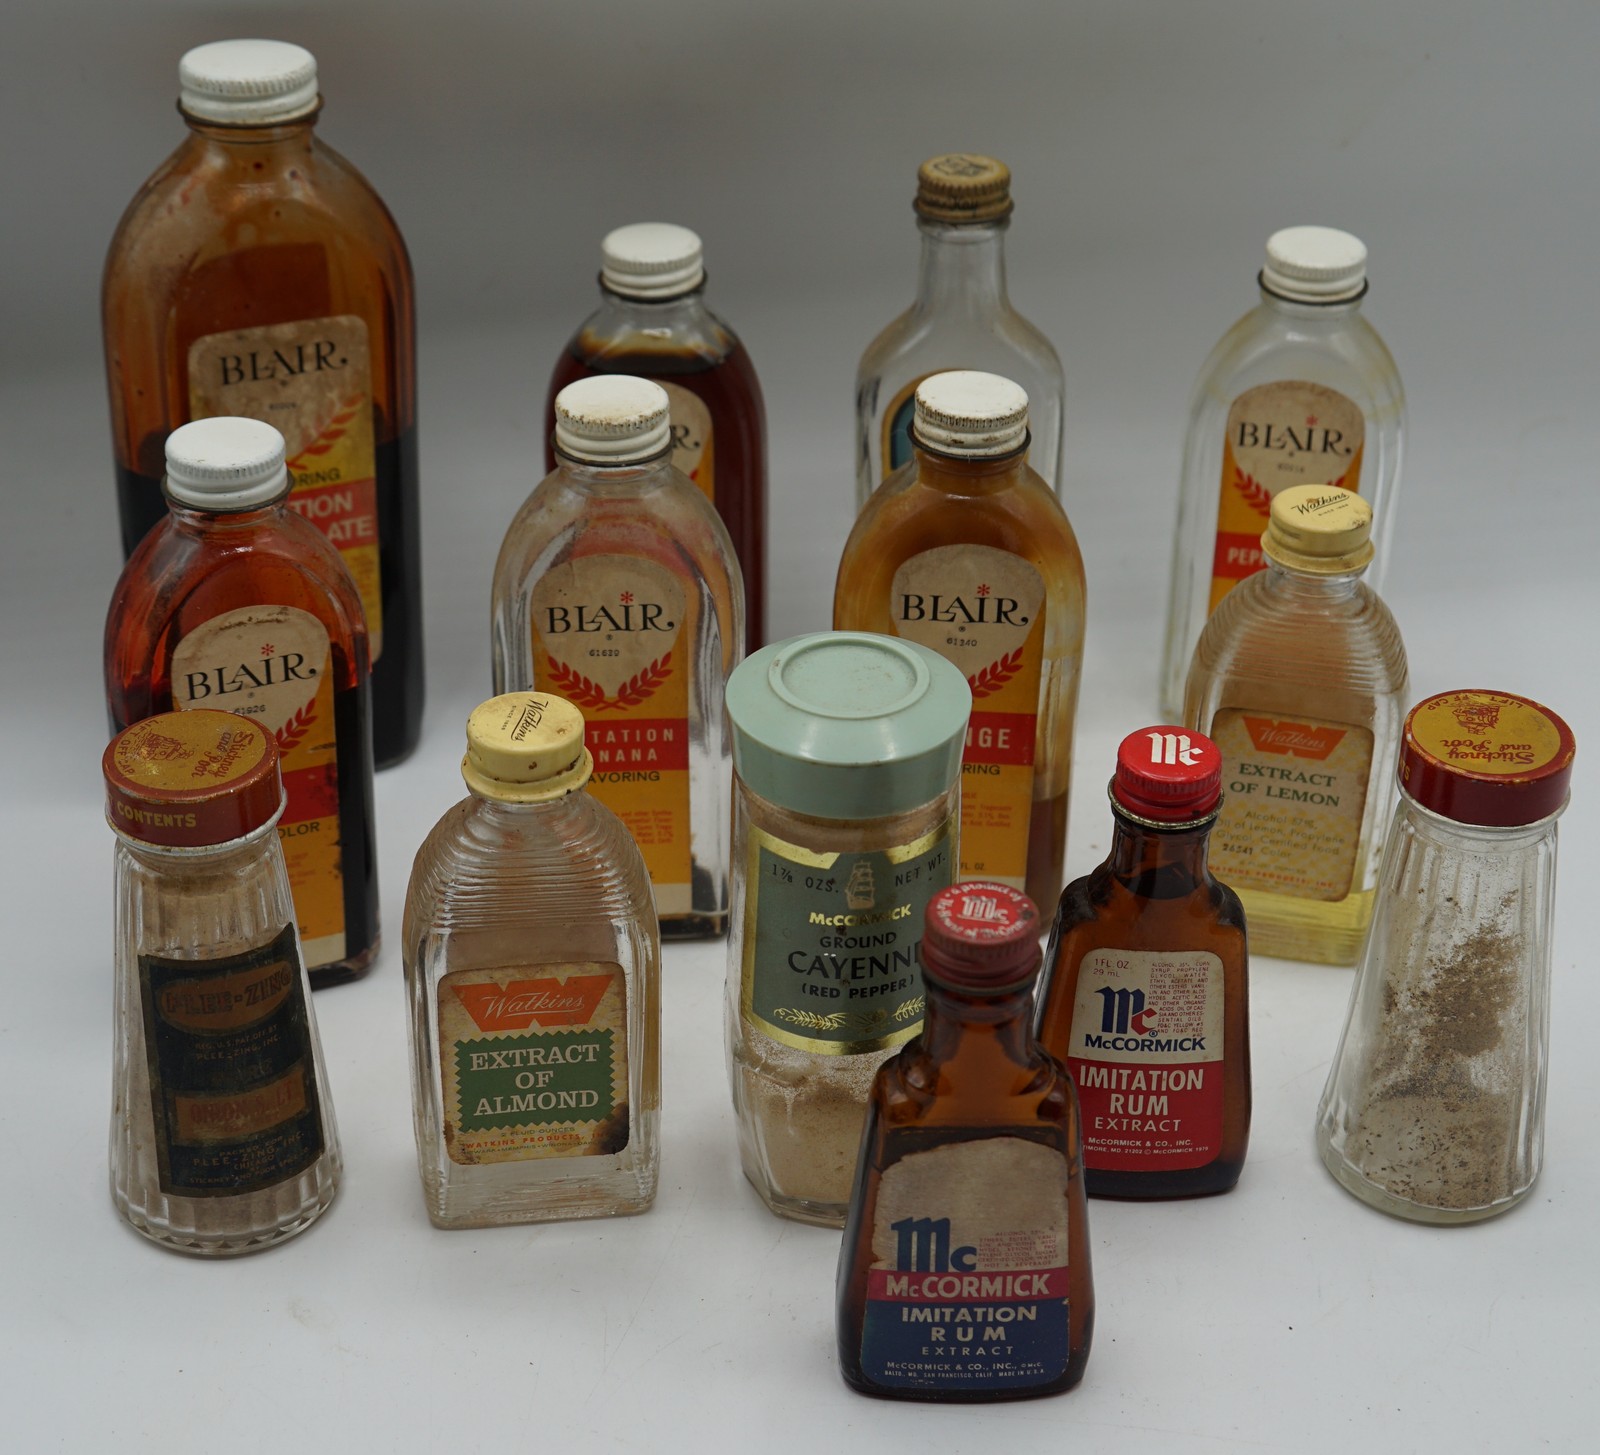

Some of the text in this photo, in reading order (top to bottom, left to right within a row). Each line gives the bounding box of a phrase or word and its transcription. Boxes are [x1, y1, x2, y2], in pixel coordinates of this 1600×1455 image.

[1291, 492, 1350, 516] Watkins
[511, 698, 550, 742] Watkins
[216, 731, 232, 754] and
[591, 728, 675, 744] TATION
[1258, 727, 1327, 750] Watkins
[214, 730, 256, 779] Stickney
[599, 748, 658, 763] NANA
[1447, 747, 1536, 766] Stickney
[1499, 743, 1533, 753] and
[1238, 762, 1337, 788] EXTRACT
[1229, 780, 1341, 808] OF LEMON
[116, 801, 197, 828] CONTENTS
[1245, 810, 1288, 825] Alcohol
[1234, 821, 1246, 830] of
[894, 852, 947, 888] NET WT.
[819, 931, 897, 950] GROUND
[1092, 968, 1104, 976] 29
[801, 973, 915, 999] (RED PEPPER)
[480, 991, 585, 1020] Watkins
[1085, 1033, 1207, 1052] McCORMICK
[469, 1043, 600, 1072] EXTRACT
[514, 1070, 554, 1090] OF
[1079, 1064, 1204, 1092] IMITATION
[473, 1089, 599, 1117] ALMOND
[1109, 1093, 1169, 1117] RUM
[511, 1129, 536, 1137] FLUID
[537, 1126, 576, 1135] OUNCES
[1094, 1116, 1182, 1133] EXTRACT
[464, 1139, 516, 1150] WATKINS
[1088, 1136, 1142, 1148] McCORMICK
[1145, 1140, 1152, 1148] &
[1175, 1139, 1193, 1147] INC.
[1153, 1147, 1193, 1155] McCORMICK
[885, 1273, 1052, 1299] McCORMICK
[902, 1305, 1038, 1323] IMITATION
[930, 1326, 1007, 1342] RUM
[921, 1346, 1014, 1357] EXTRACT
[886, 1360, 951, 1372] McCORMICK
[923, 1371, 937, 1379] SAN
[998, 1370, 1016, 1378] MADE
